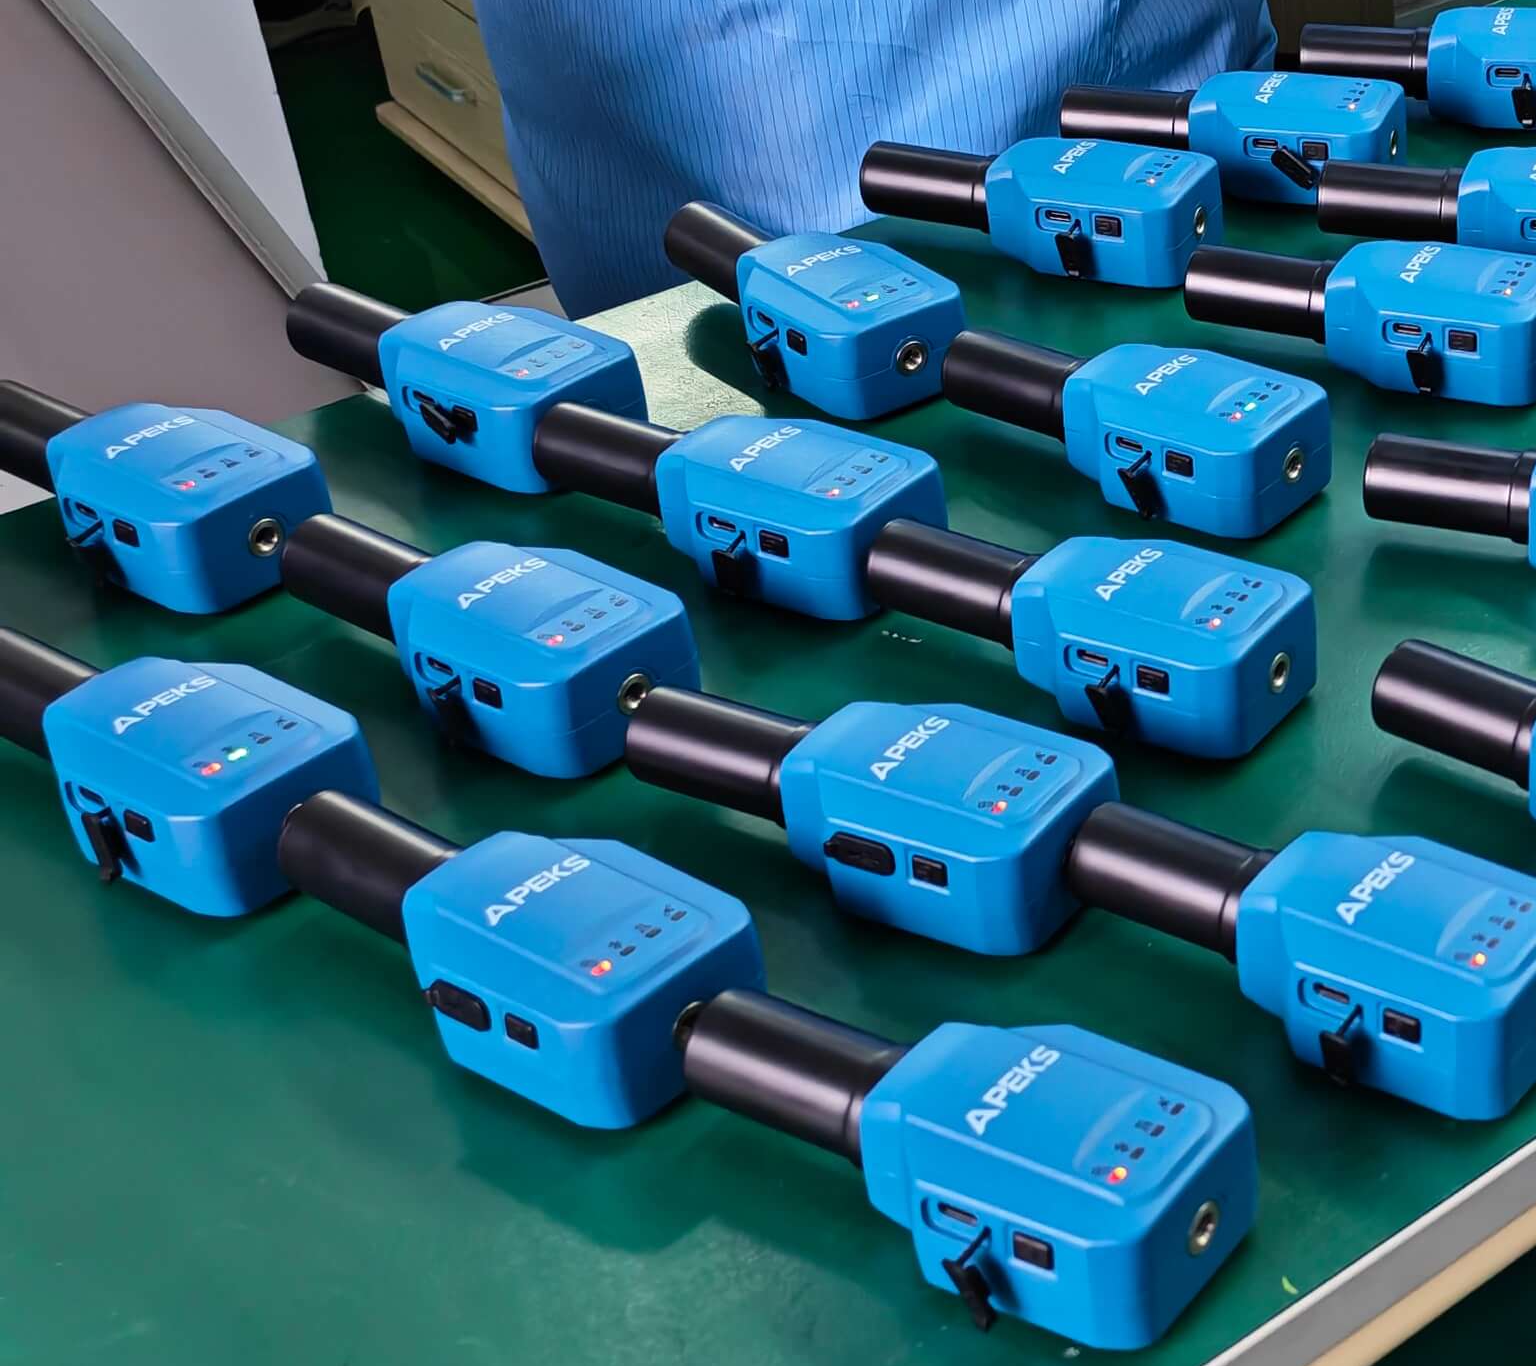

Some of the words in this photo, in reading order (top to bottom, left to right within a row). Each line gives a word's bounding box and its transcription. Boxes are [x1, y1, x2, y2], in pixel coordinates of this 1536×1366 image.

[1491, 7, 1516, 36] APEKS
[1254, 71, 1289, 104] APEKS
[1052, 142, 1097, 175] APEKS
[786, 245, 862, 277] APEKS
[1399, 245, 1441, 284] APEKS
[438, 312, 516, 351] APEKS
[1134, 354, 1198, 396] APEKS
[105, 415, 195, 460] APEKS
[729, 425, 802, 472] APEKS
[457, 557, 548, 610] APEKS
[1095, 548, 1164, 602] APEKS
[112, 675, 217, 735] APEKS
[870, 716, 950, 781] APEKS
[484, 854, 591, 927] APEKS
[1335, 851, 1415, 925] APEKS
[965, 1045, 1060, 1136] APEKS
